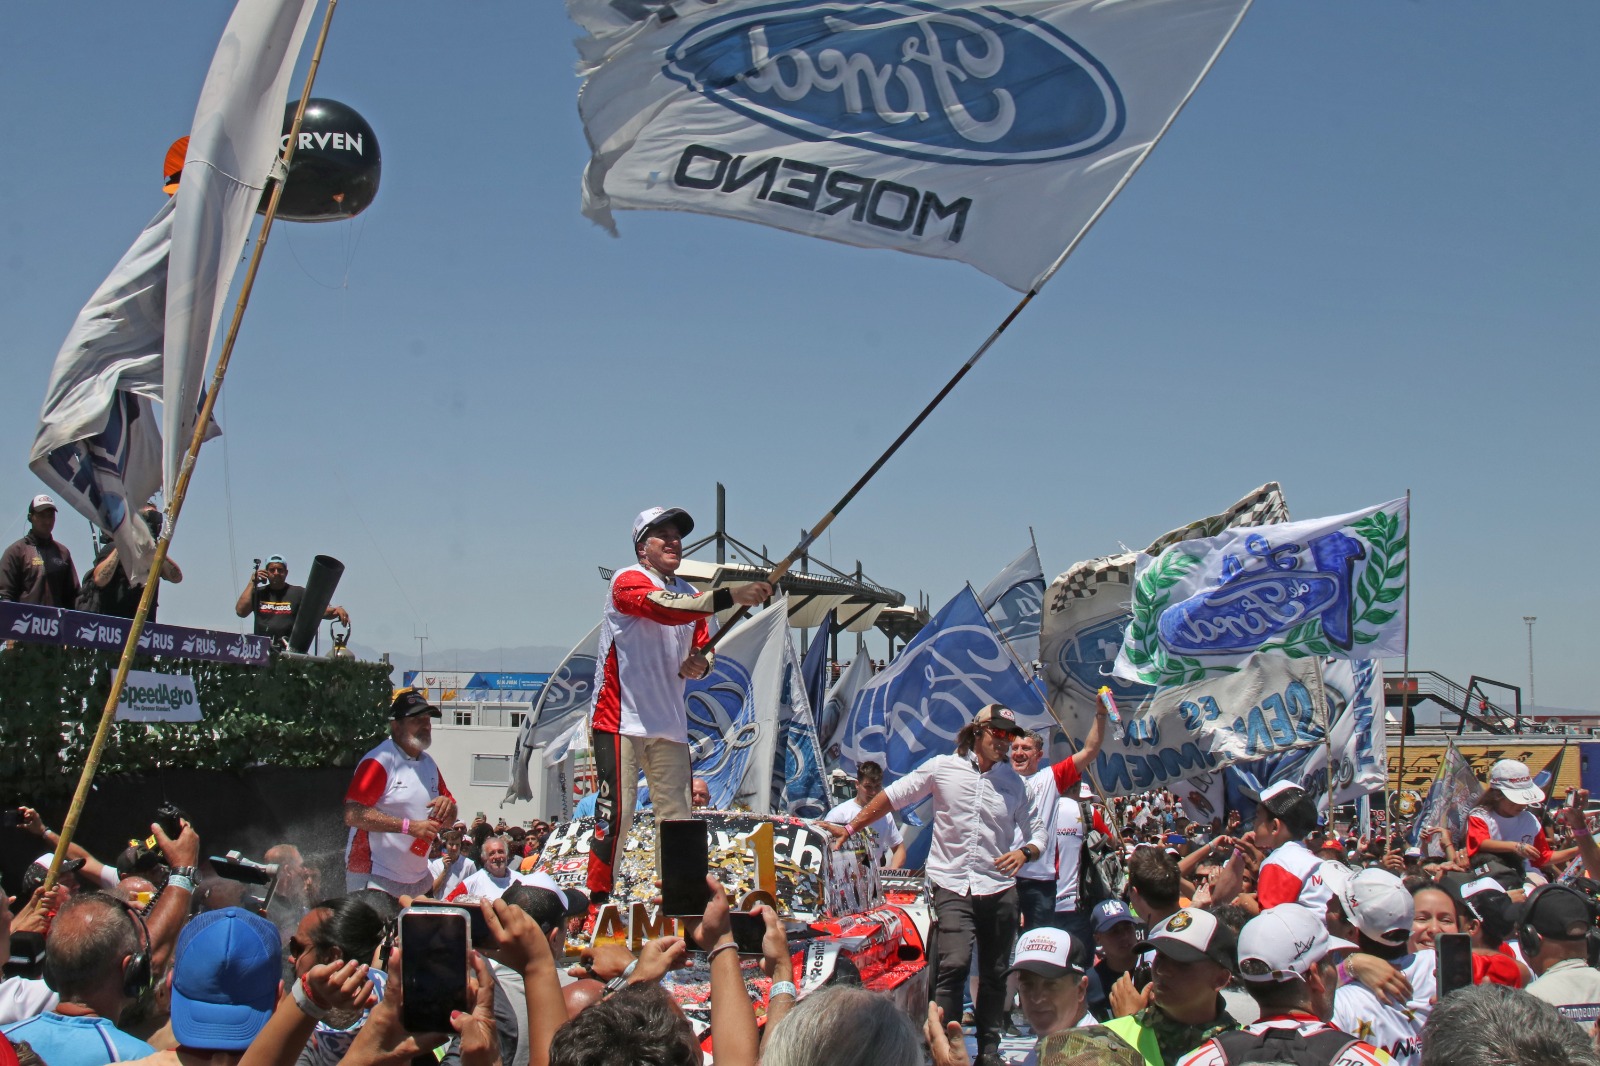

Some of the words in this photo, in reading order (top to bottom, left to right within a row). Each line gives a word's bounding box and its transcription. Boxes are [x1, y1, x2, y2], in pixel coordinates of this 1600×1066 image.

[31, 617, 60, 637] RUS
[98, 625, 122, 645] RUS
[152, 633, 174, 651] RUS
[195, 638, 216, 656] RUS
[119, 682, 194, 710] SpeedAgro
